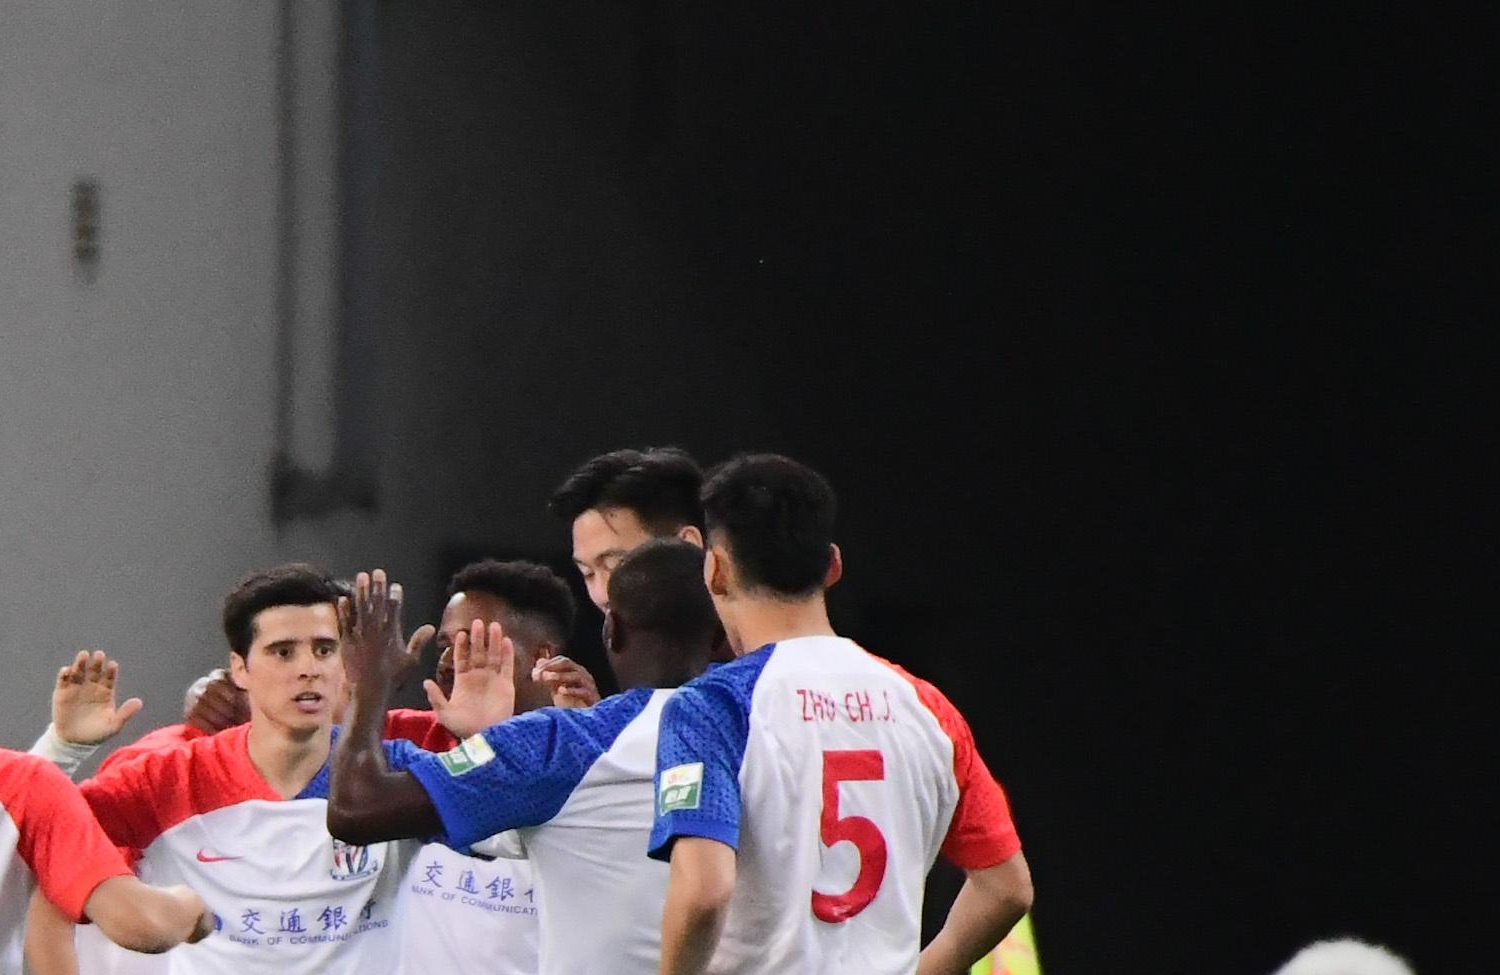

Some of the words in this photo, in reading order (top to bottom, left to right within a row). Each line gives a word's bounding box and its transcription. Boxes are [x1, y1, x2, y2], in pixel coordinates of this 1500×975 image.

[811, 749, 888, 924] 5
[441, 891, 456, 903] OF
[266, 935, 283, 947] OF
